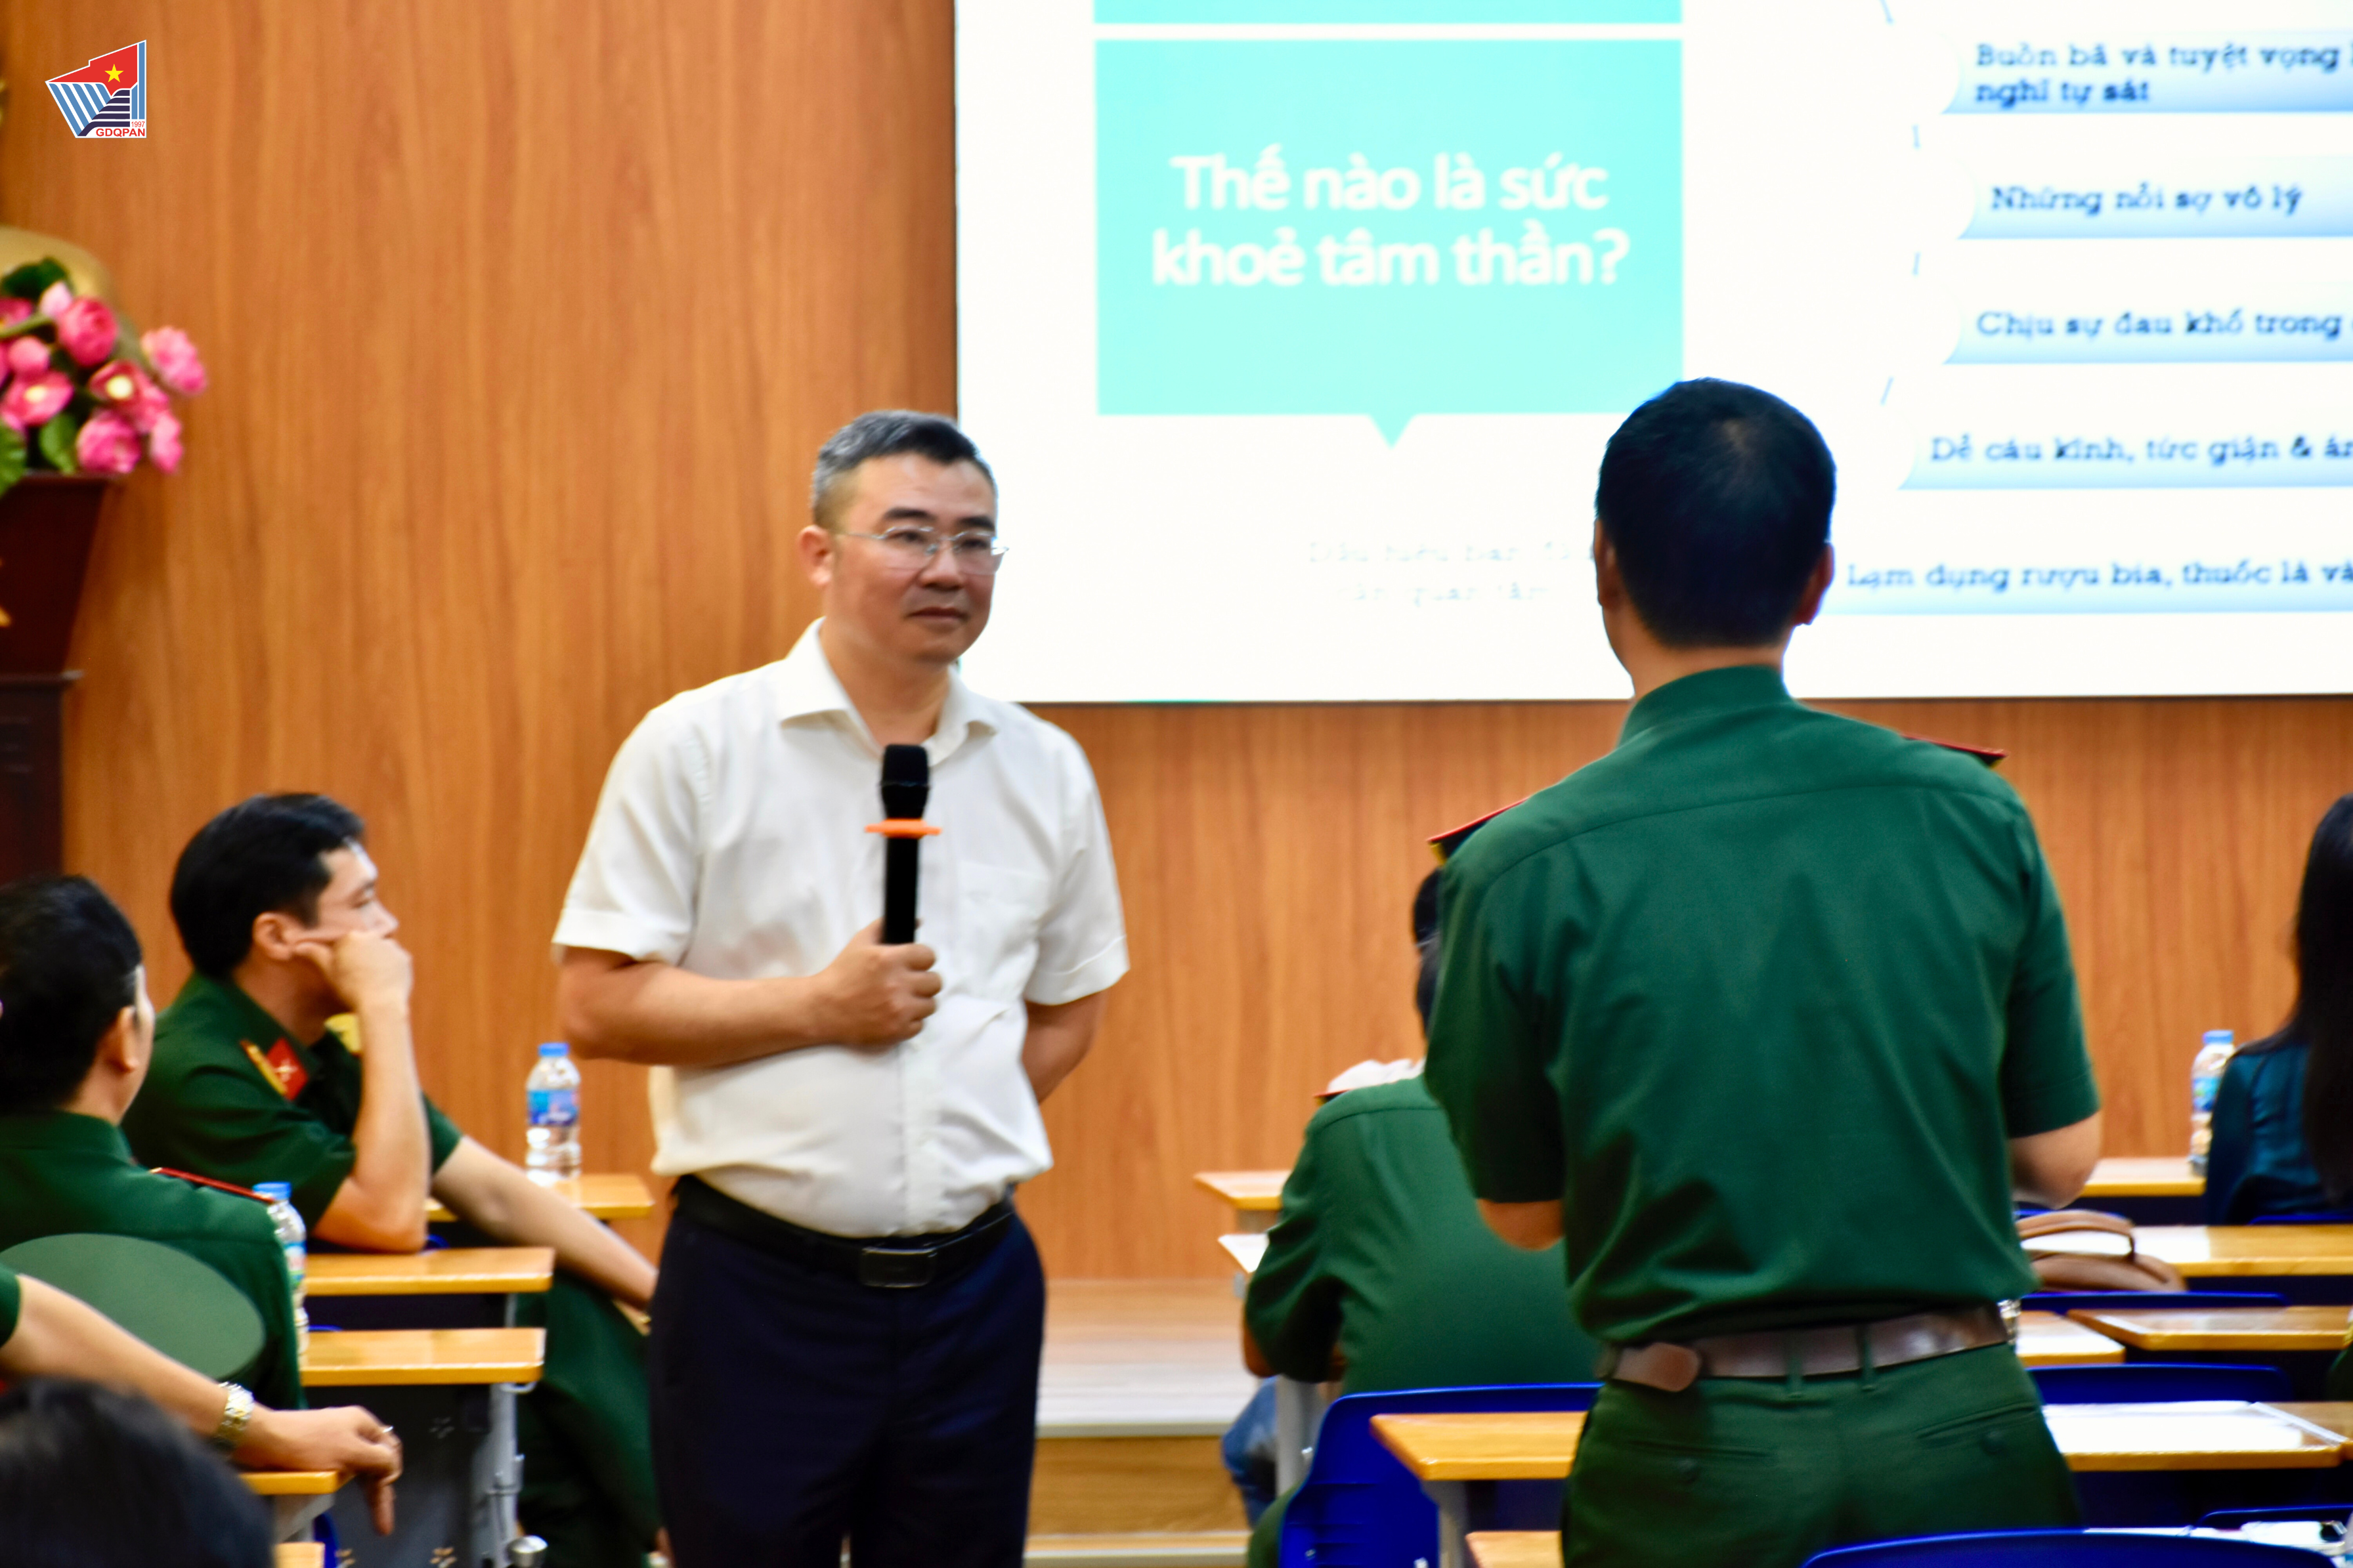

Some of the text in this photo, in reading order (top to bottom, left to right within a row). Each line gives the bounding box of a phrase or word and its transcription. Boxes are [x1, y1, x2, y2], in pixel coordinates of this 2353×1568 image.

[2260, 47, 2341, 74] vọng
[2103, 78, 2150, 102] sát
[1168, 142, 1610, 211] Thế nào là sức
[1151, 218, 1632, 286] khoẻ tâm thần?
[1976, 310, 2054, 341] Chịu
[2113, 312, 2172, 335] đau
[2255, 314, 2342, 343] trong
[2291, 434, 2312, 459] &
[1926, 563, 2010, 593] dụng
[2111, 563, 2172, 589] bia,
[2183, 559, 2270, 584] thuốc
[2281, 561, 2308, 583] là
